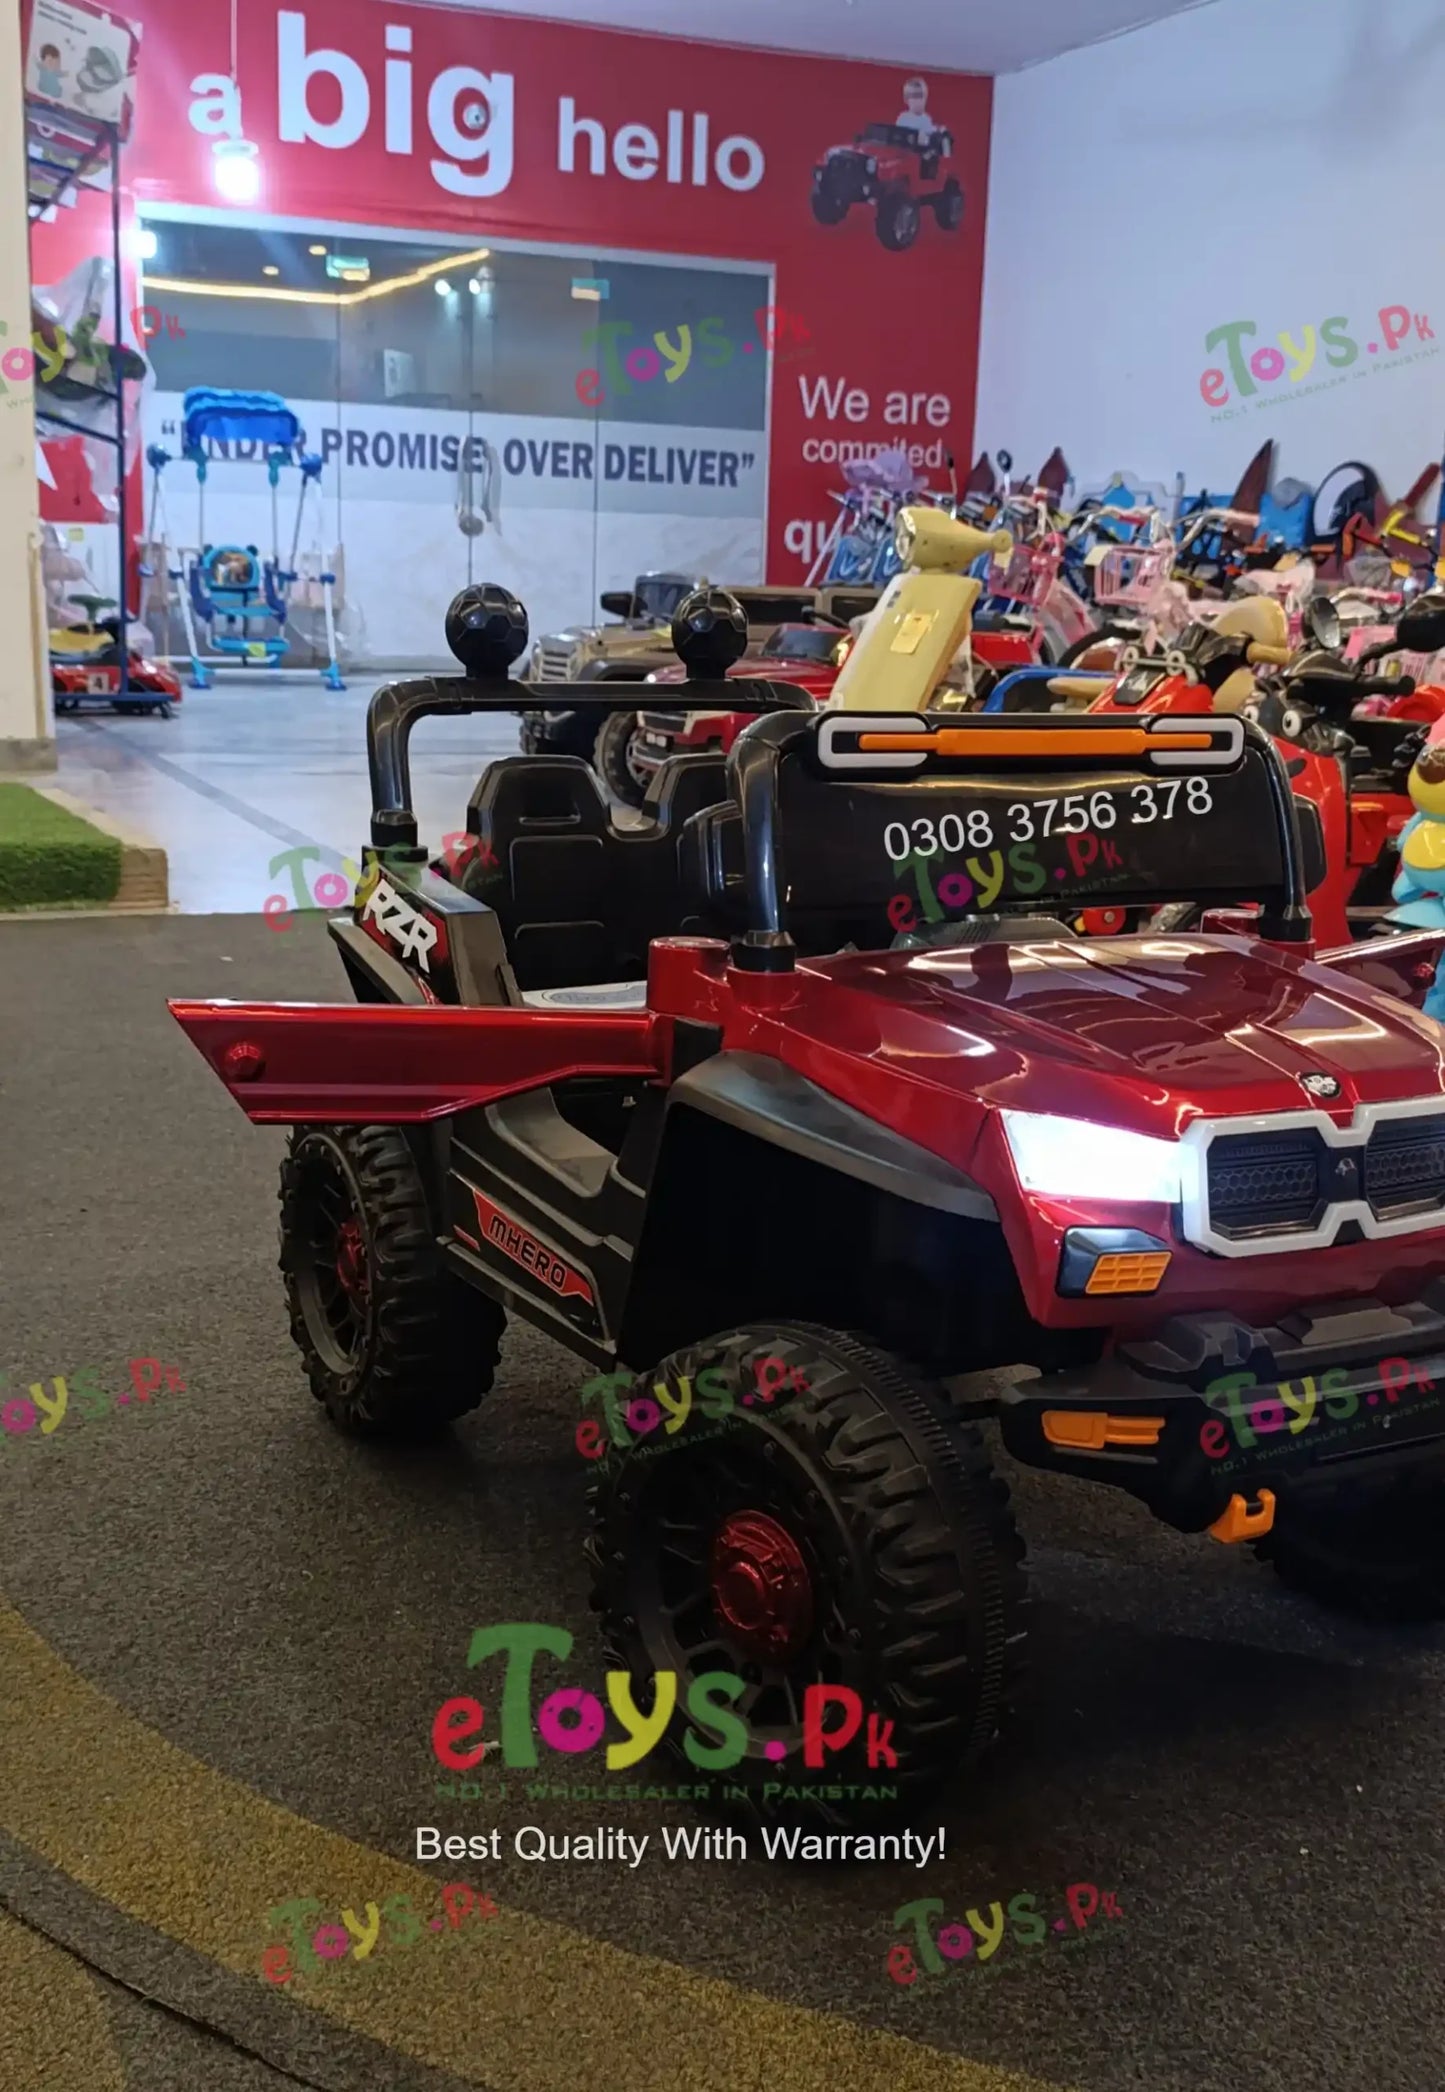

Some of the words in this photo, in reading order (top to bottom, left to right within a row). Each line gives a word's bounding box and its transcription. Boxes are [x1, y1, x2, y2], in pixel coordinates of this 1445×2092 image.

[188, 73, 243, 139] a
[278, 10, 514, 197] big
[558, 96, 765, 191] hello
[798, 375, 869, 422] We
[884, 391, 950, 427] are
[321, 428, 485, 473] PROMISE
[503, 439, 594, 480] OVER
[363, 878, 438, 974] RZR
[489, 1214, 568, 1289] MHERO
